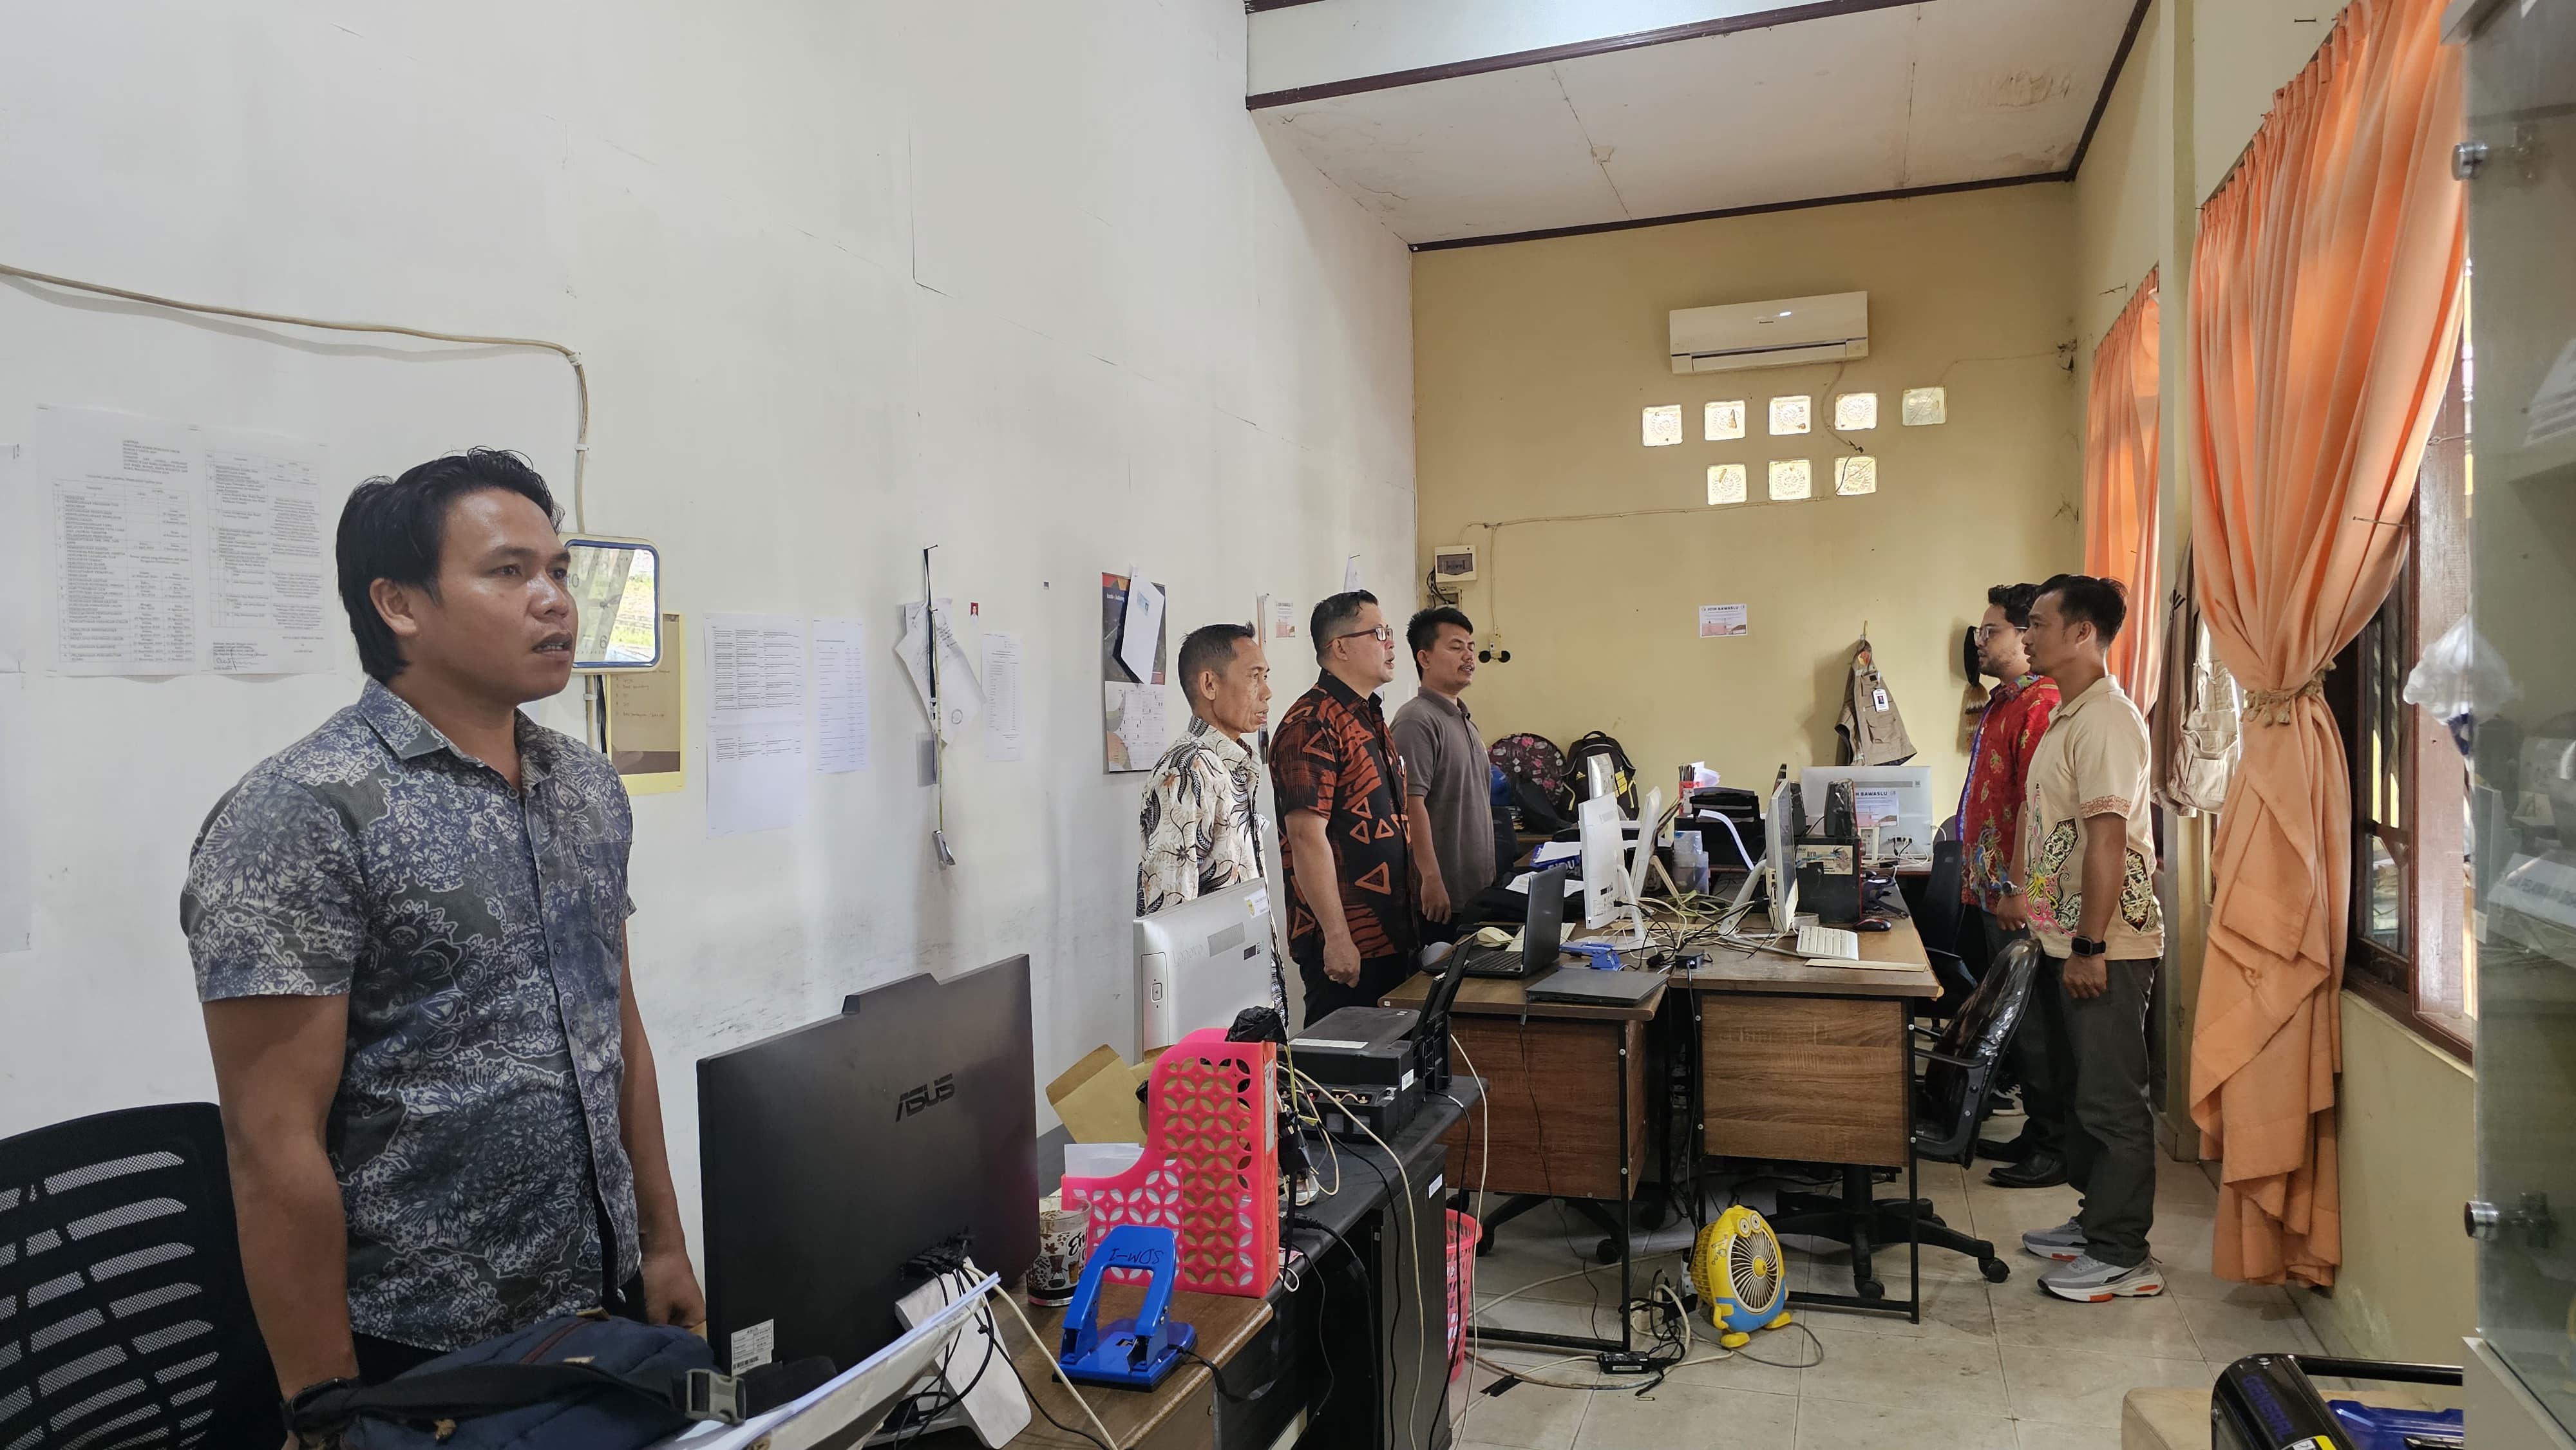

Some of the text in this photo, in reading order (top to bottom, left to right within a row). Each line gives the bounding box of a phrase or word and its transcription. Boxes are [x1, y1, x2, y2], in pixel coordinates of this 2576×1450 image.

[600, 635, 607, 649] 6
[896, 1073, 955, 1122] ASUS
[2242, 1374, 2295, 1443] GENERAL
